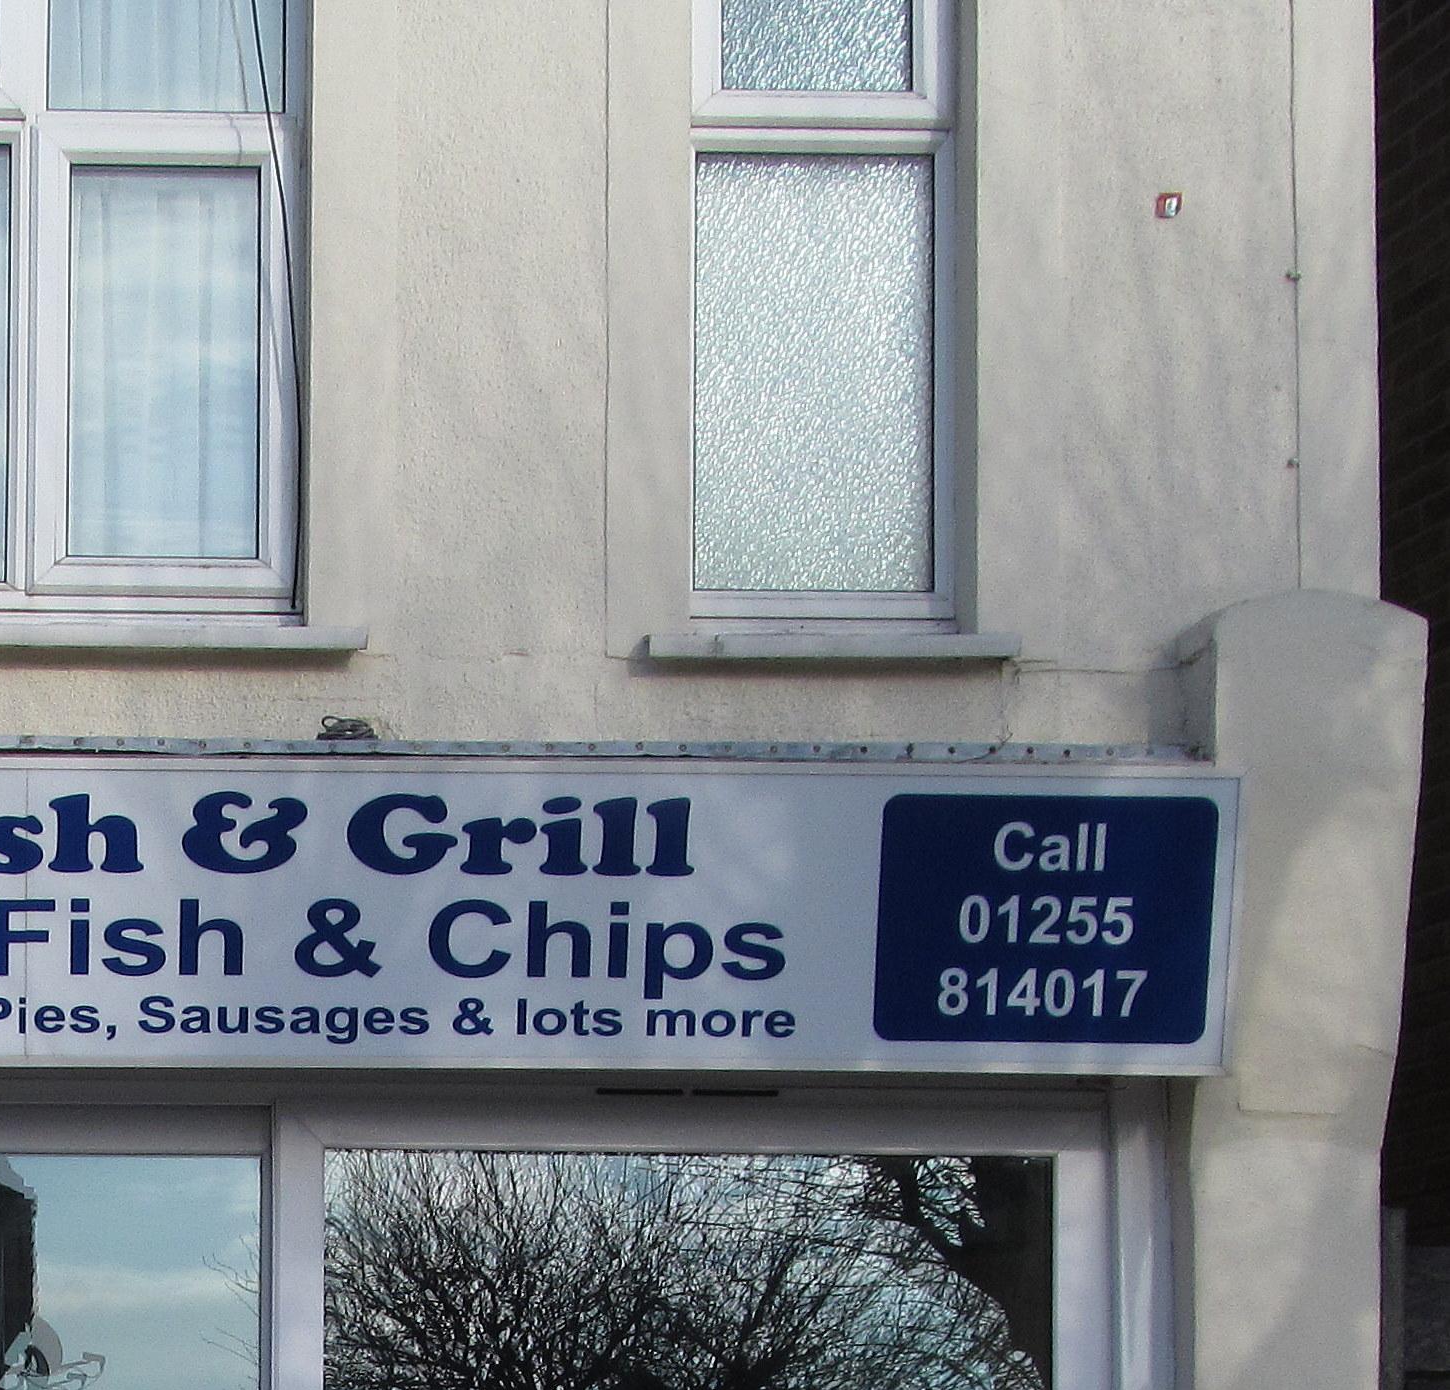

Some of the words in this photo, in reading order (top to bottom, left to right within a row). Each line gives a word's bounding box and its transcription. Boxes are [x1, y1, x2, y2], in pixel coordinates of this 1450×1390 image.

[182, 791, 307, 876] &
[347, 794, 694, 878] Grill
[993, 821, 1107, 872] Call
[959, 895, 1134, 945] 01255
[295, 899, 382, 978] &
[428, 899, 787, 1000] Chips
[937, 968, 1148, 1018] 814017
[138, 996, 430, 1045] Sausages
[453, 998, 494, 1036] &
[517, 998, 623, 1037] lots
[644, 1000, 796, 1038] more
